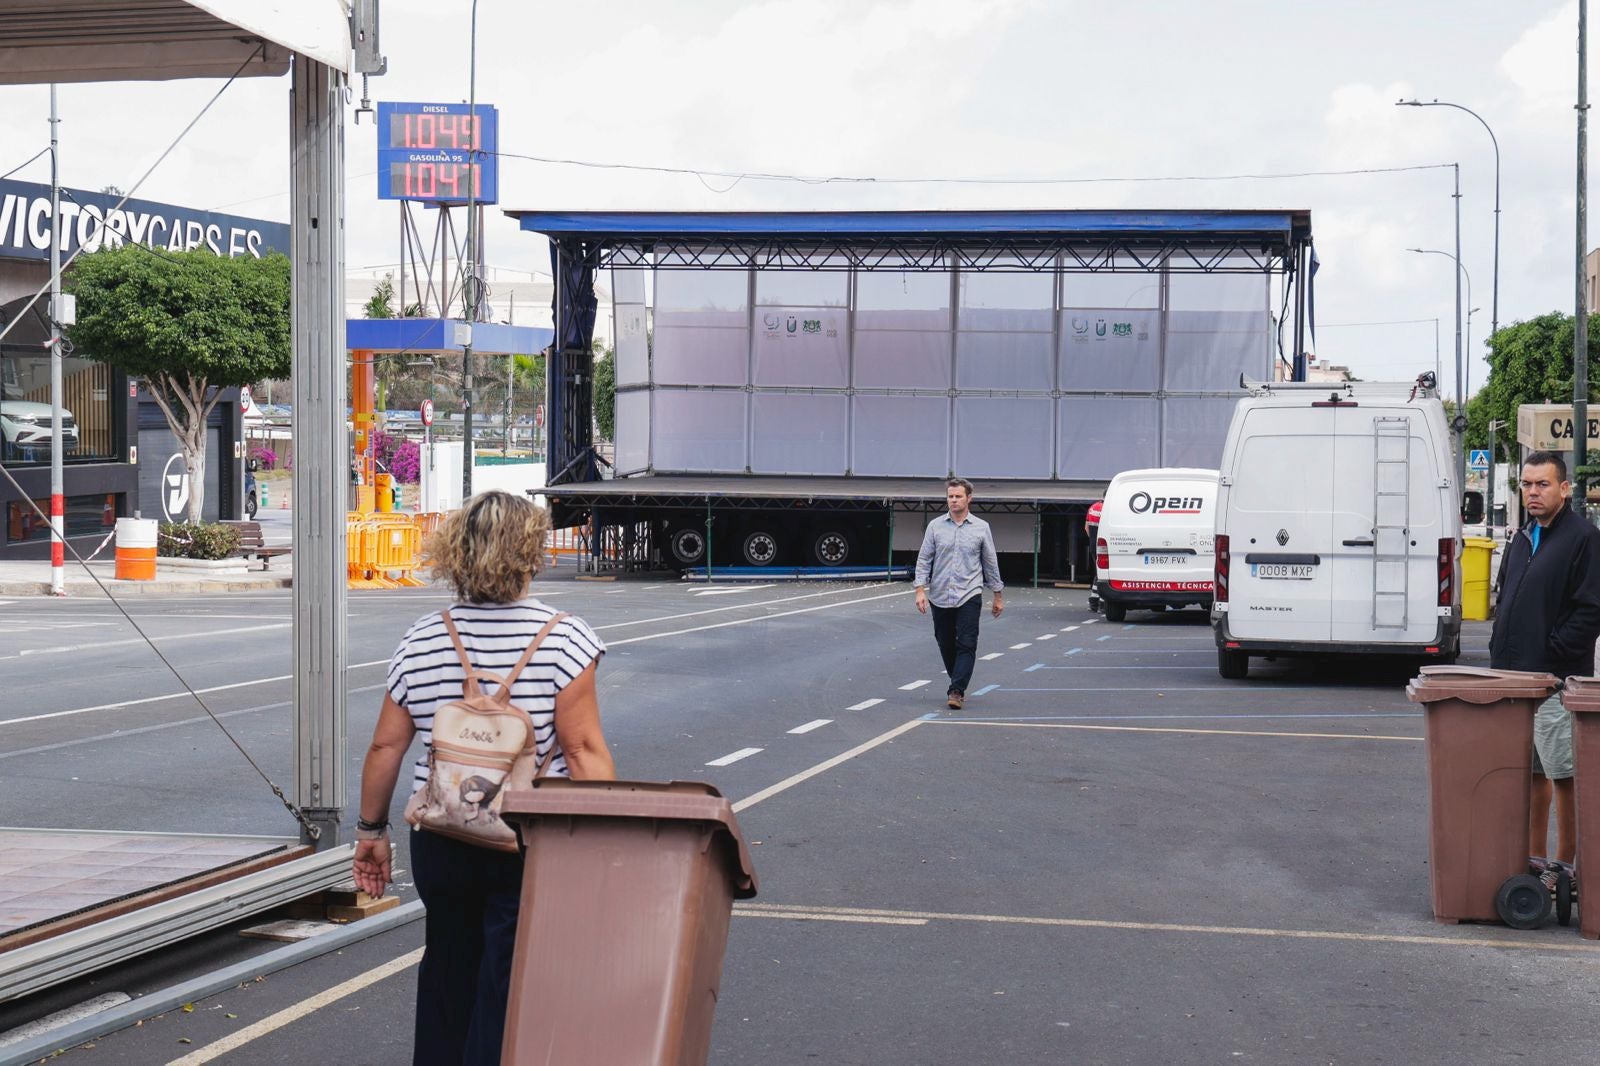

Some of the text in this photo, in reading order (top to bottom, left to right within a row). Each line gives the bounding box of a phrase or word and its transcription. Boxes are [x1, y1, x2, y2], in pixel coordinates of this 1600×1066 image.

[423, 105, 449, 113] DIESEL
[410, 154, 450, 162] GASOLINA
[1128, 491, 1203, 514] Opein
[1150, 556, 1186, 564] 9167 FVX
[1259, 566, 1313, 577] 0008 MXP
